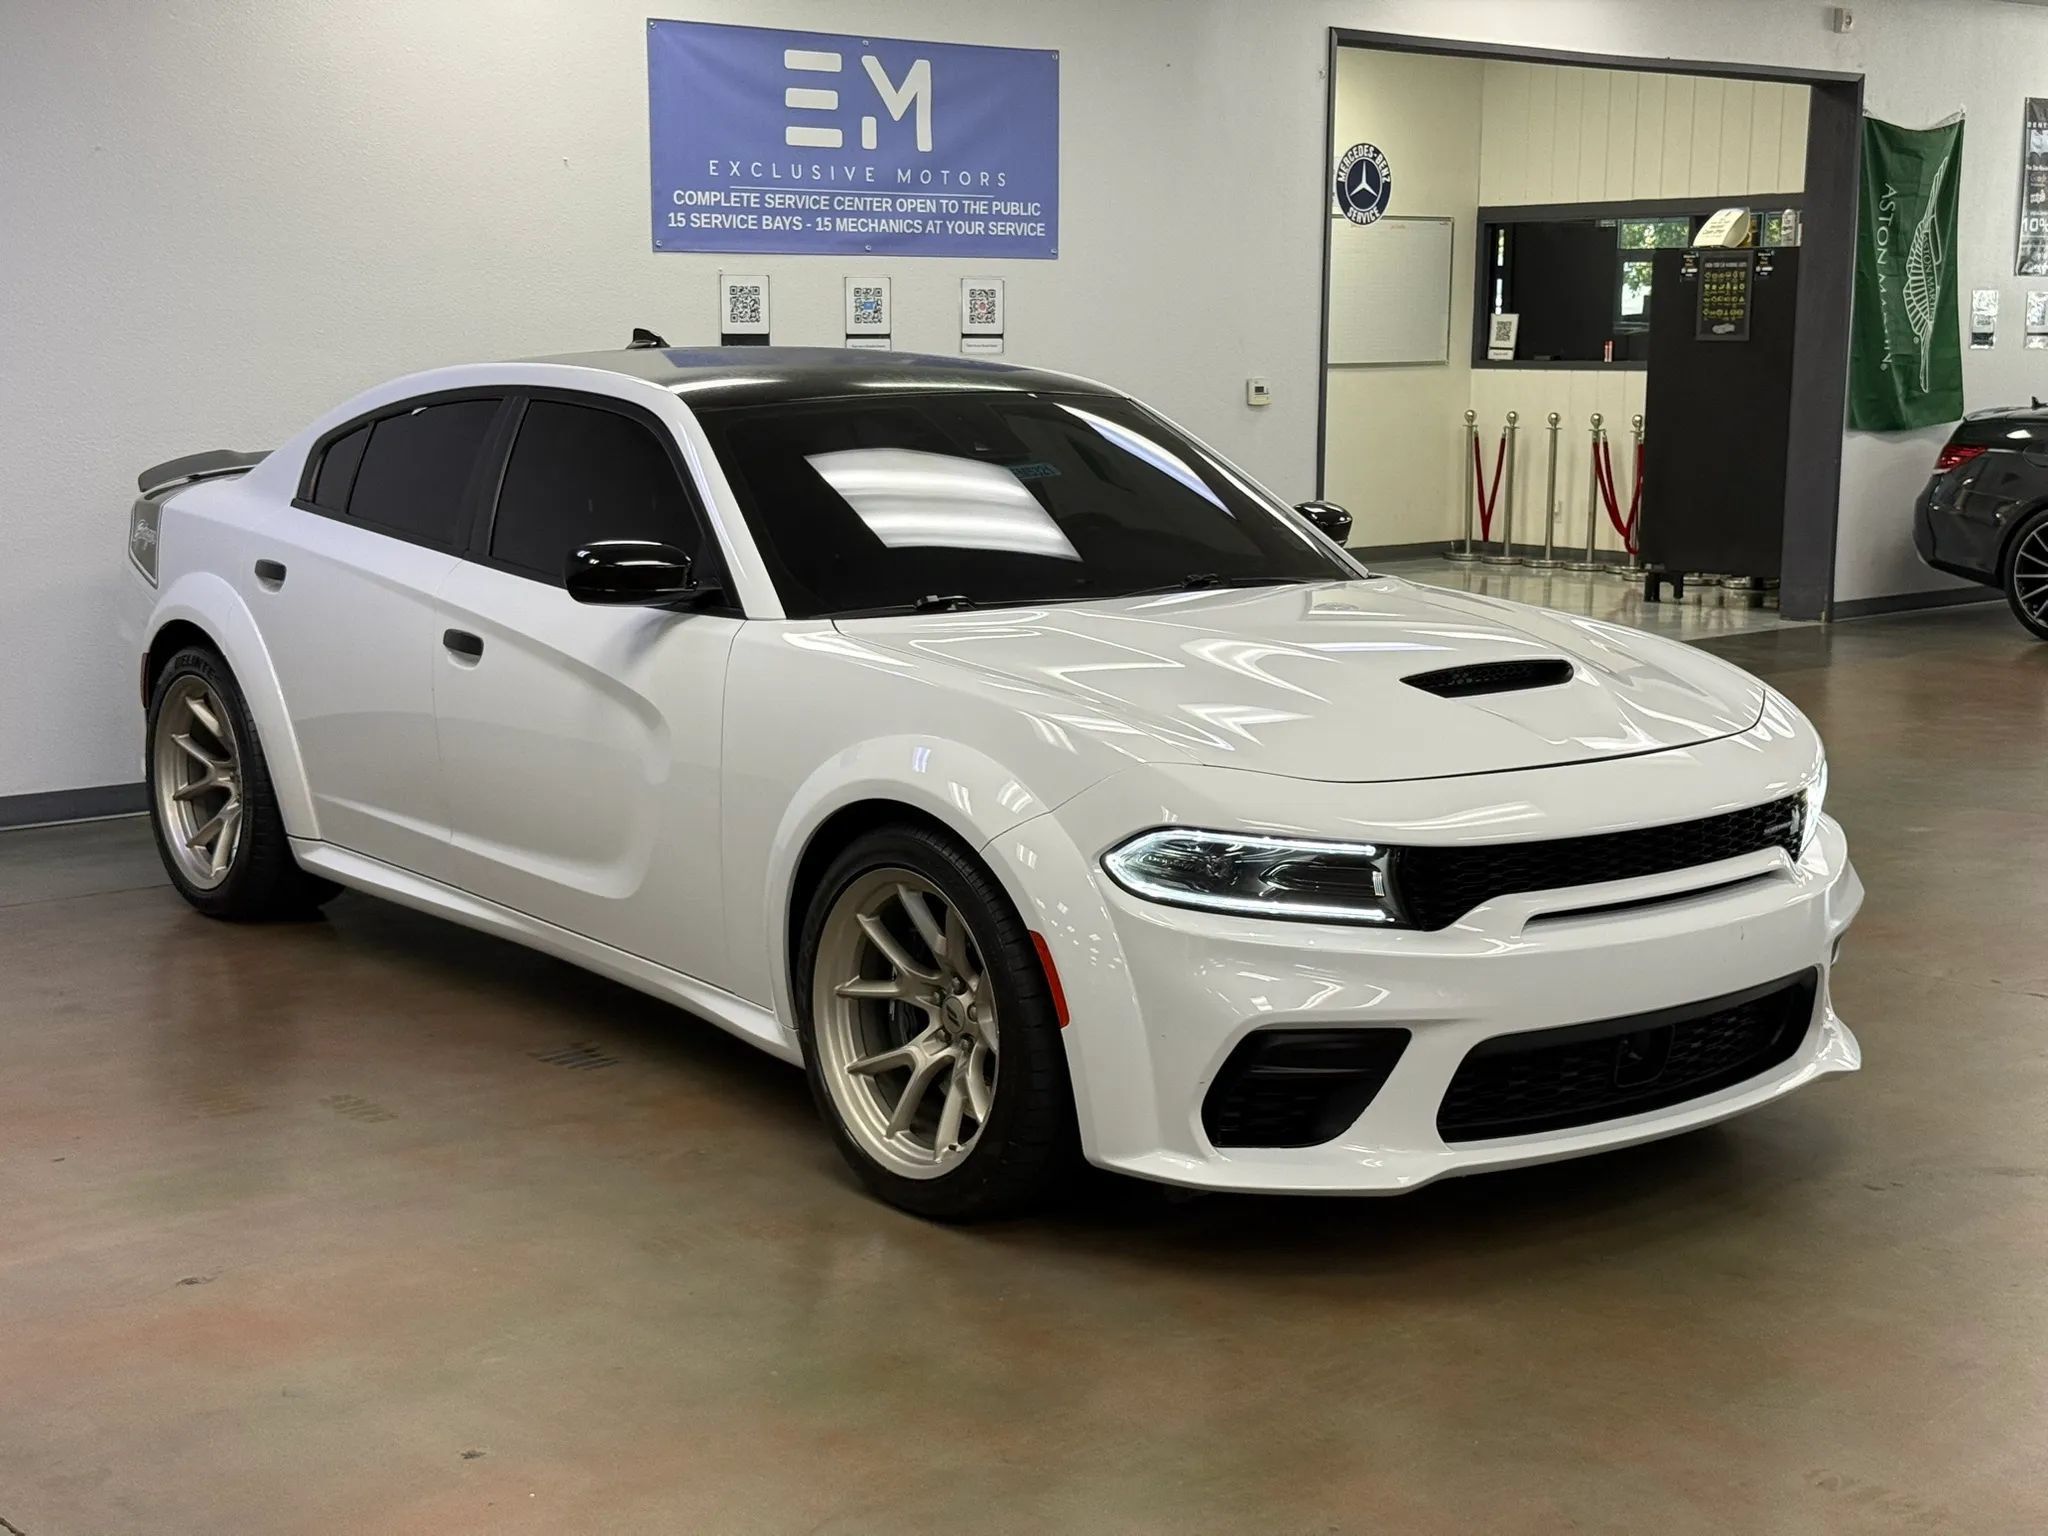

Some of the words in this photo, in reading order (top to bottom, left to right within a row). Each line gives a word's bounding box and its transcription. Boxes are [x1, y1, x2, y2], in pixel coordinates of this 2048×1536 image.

[784, 49, 932, 152] EM
[709, 160, 875, 182] EXCLUSIVE
[897, 168, 1006, 187] MOTORS
[673, 190, 760, 208] COMPLETE
[764, 193, 829, 210] SERVICE
[834, 195, 892, 212] CENTER
[896, 198, 936, 213] OPEN
[940, 200, 959, 214] TO
[962, 200, 989, 215] THE
[992, 201, 1041, 216] PUBLIC
[1347, 206, 1380, 225] SERVICE
[667, 212, 686, 227] 15
[690, 213, 758, 229] SERVICE
[762, 215, 802, 230] BAYS
[815, 217, 832, 231] 15
[836, 218, 922, 234] MECHANICS
[925, 220, 943, 234] AT
[946, 220, 985, 235] YOUR
[988, 222, 1045, 236] SERVICE
[1876, 183, 1898, 265] ASTON
[1922, 233, 1933, 273] ASTON
